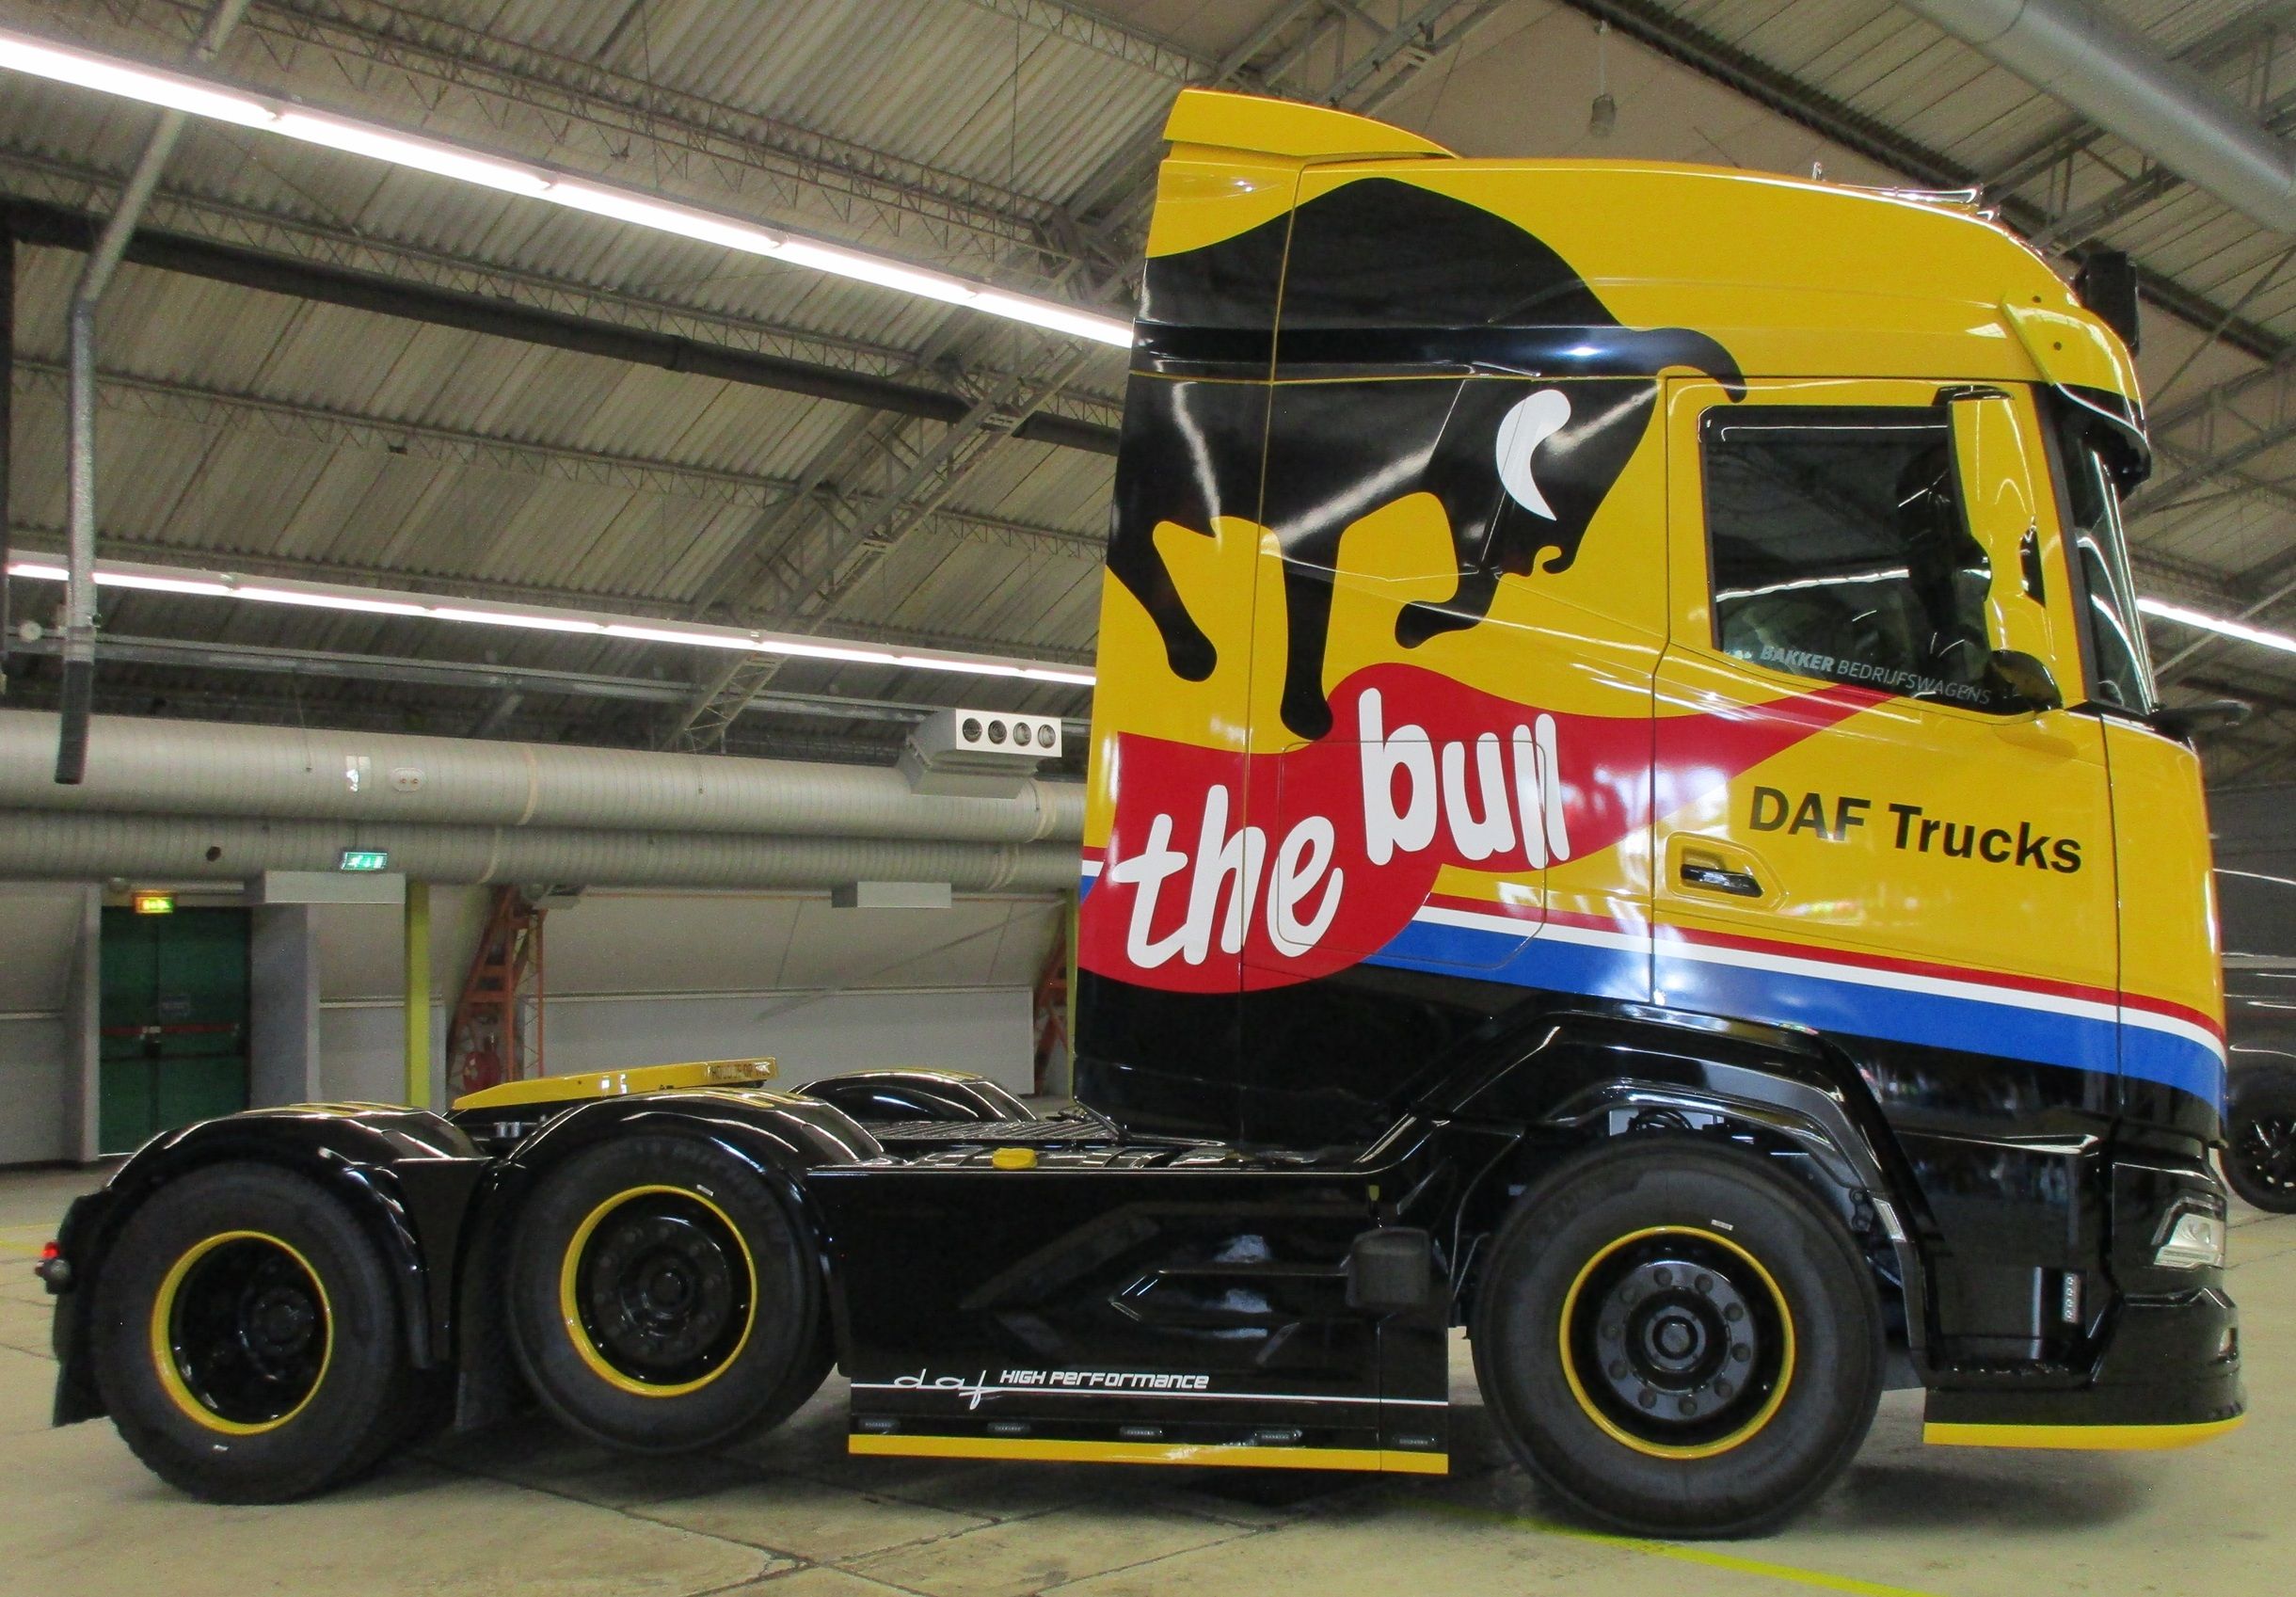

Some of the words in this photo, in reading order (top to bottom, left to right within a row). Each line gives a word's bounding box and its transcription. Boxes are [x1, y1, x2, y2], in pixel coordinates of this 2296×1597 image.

[1761, 647, 1835, 673] BAKKER
[1836, 660, 1992, 705] BEDRIJFSWAGENS
[1112, 785, 1344, 969] the
[1359, 687, 1570, 870] bull
[1749, 785, 1871, 840] DAF
[1889, 803, 2081, 873] Trucks
[1000, 1370, 1045, 1385] HIGH
